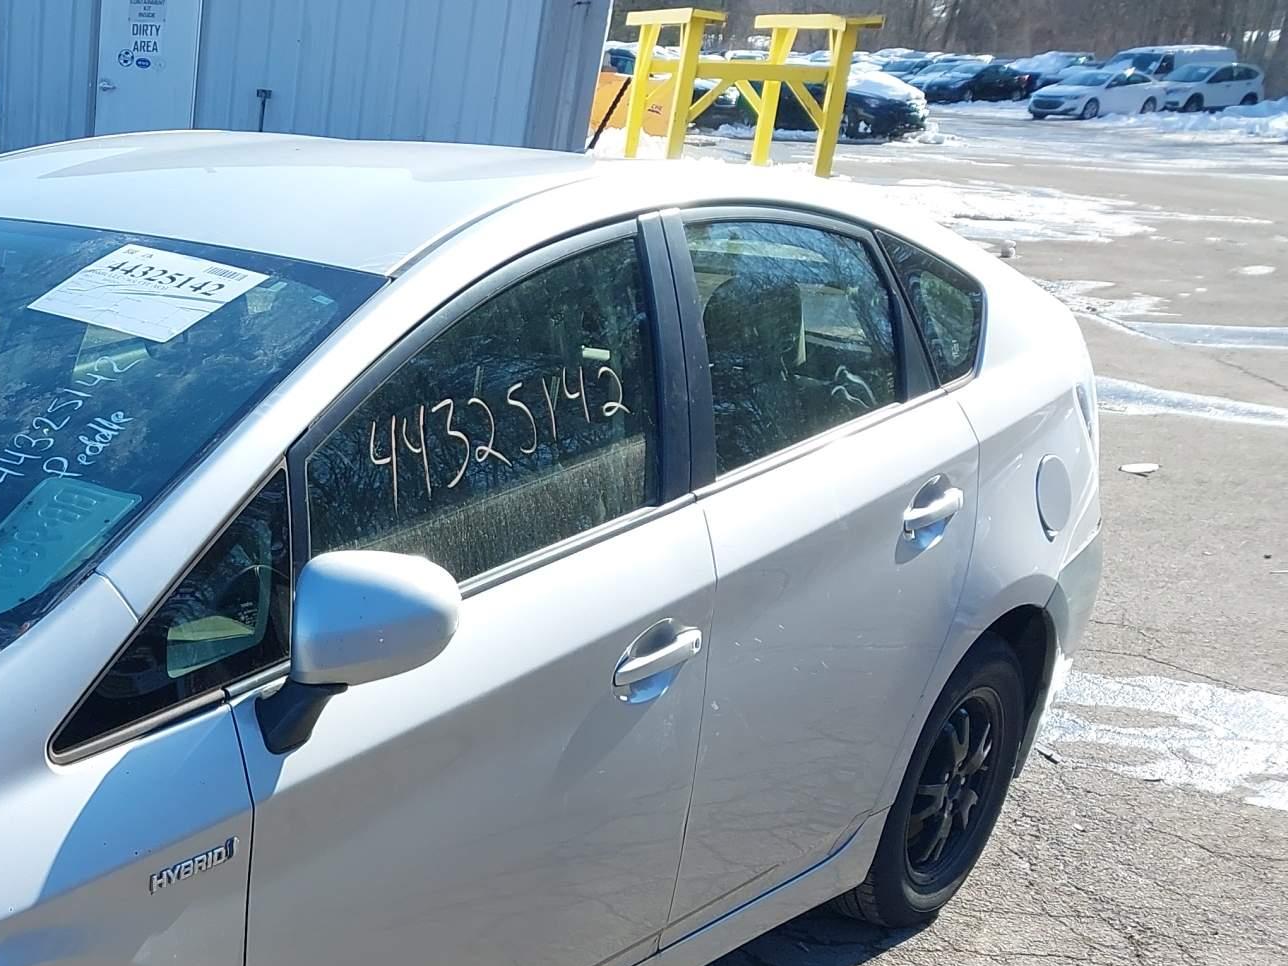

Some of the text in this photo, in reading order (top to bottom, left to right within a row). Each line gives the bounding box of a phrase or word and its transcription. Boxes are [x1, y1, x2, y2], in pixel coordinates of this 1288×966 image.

[132, 23, 161, 37] DIRTY
[132, 40, 159, 52] AREA
[107, 260, 225, 297] 44325142
[370, 365, 631, 519] 44325142
[149, 845, 227, 895] HYBRID
